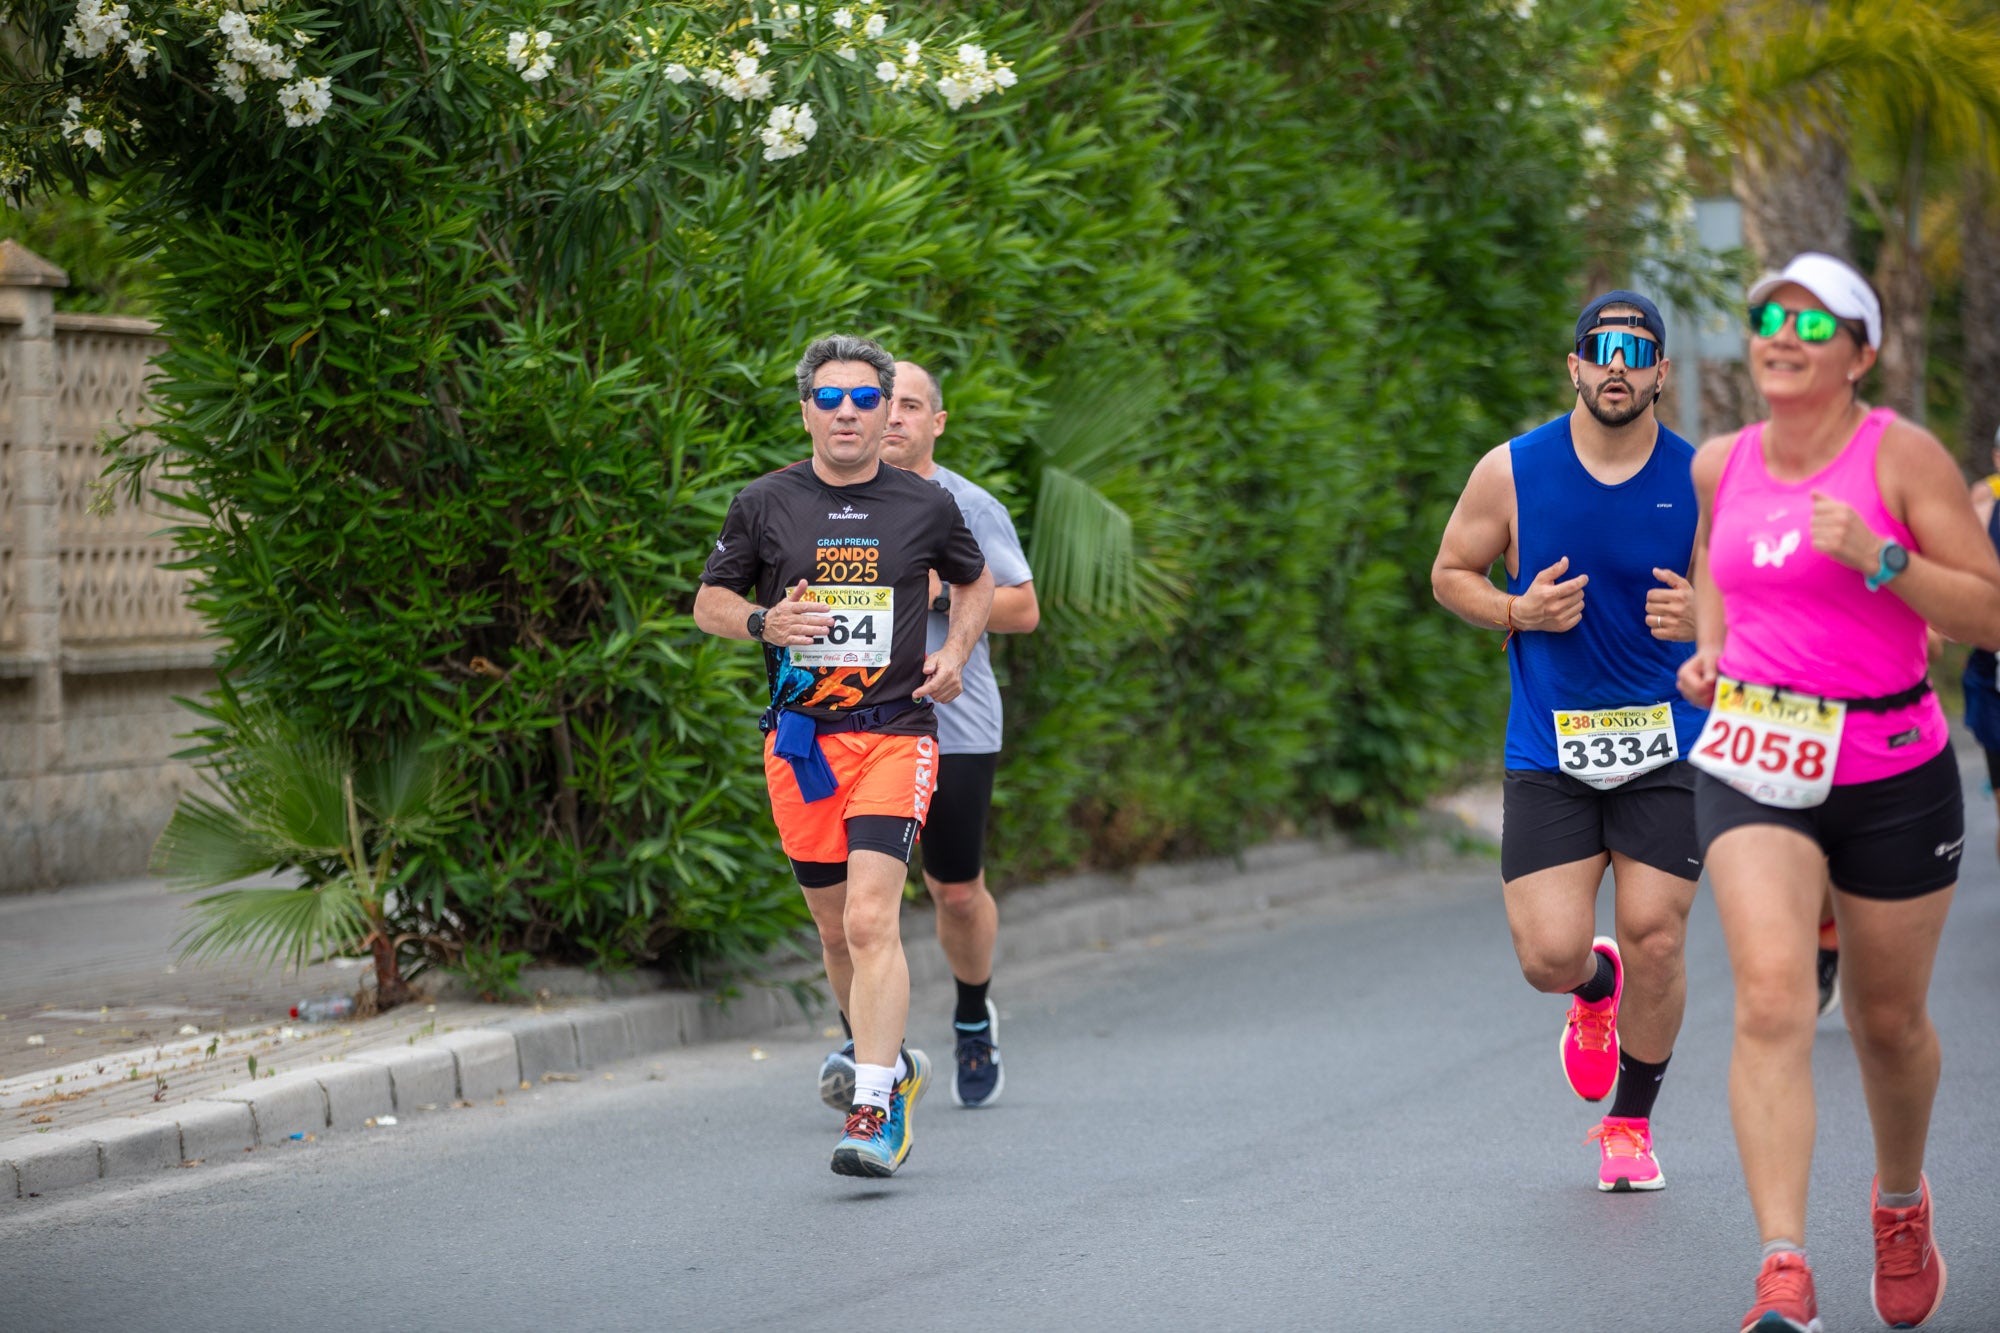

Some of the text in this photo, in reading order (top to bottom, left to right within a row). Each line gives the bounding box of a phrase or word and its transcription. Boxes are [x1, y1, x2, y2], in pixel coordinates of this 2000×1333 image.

[817, 538, 880, 547] GRAN PREMIO
[816, 547, 879, 562] FONDO
[816, 562, 879, 583] 2025
[817, 595, 870, 606] FONDO
[805, 614, 877, 645] 64
[1571, 715, 1648, 730] 38 FONDO
[1563, 733, 1673, 770] 3334
[1700, 720, 1827, 782] 2058
